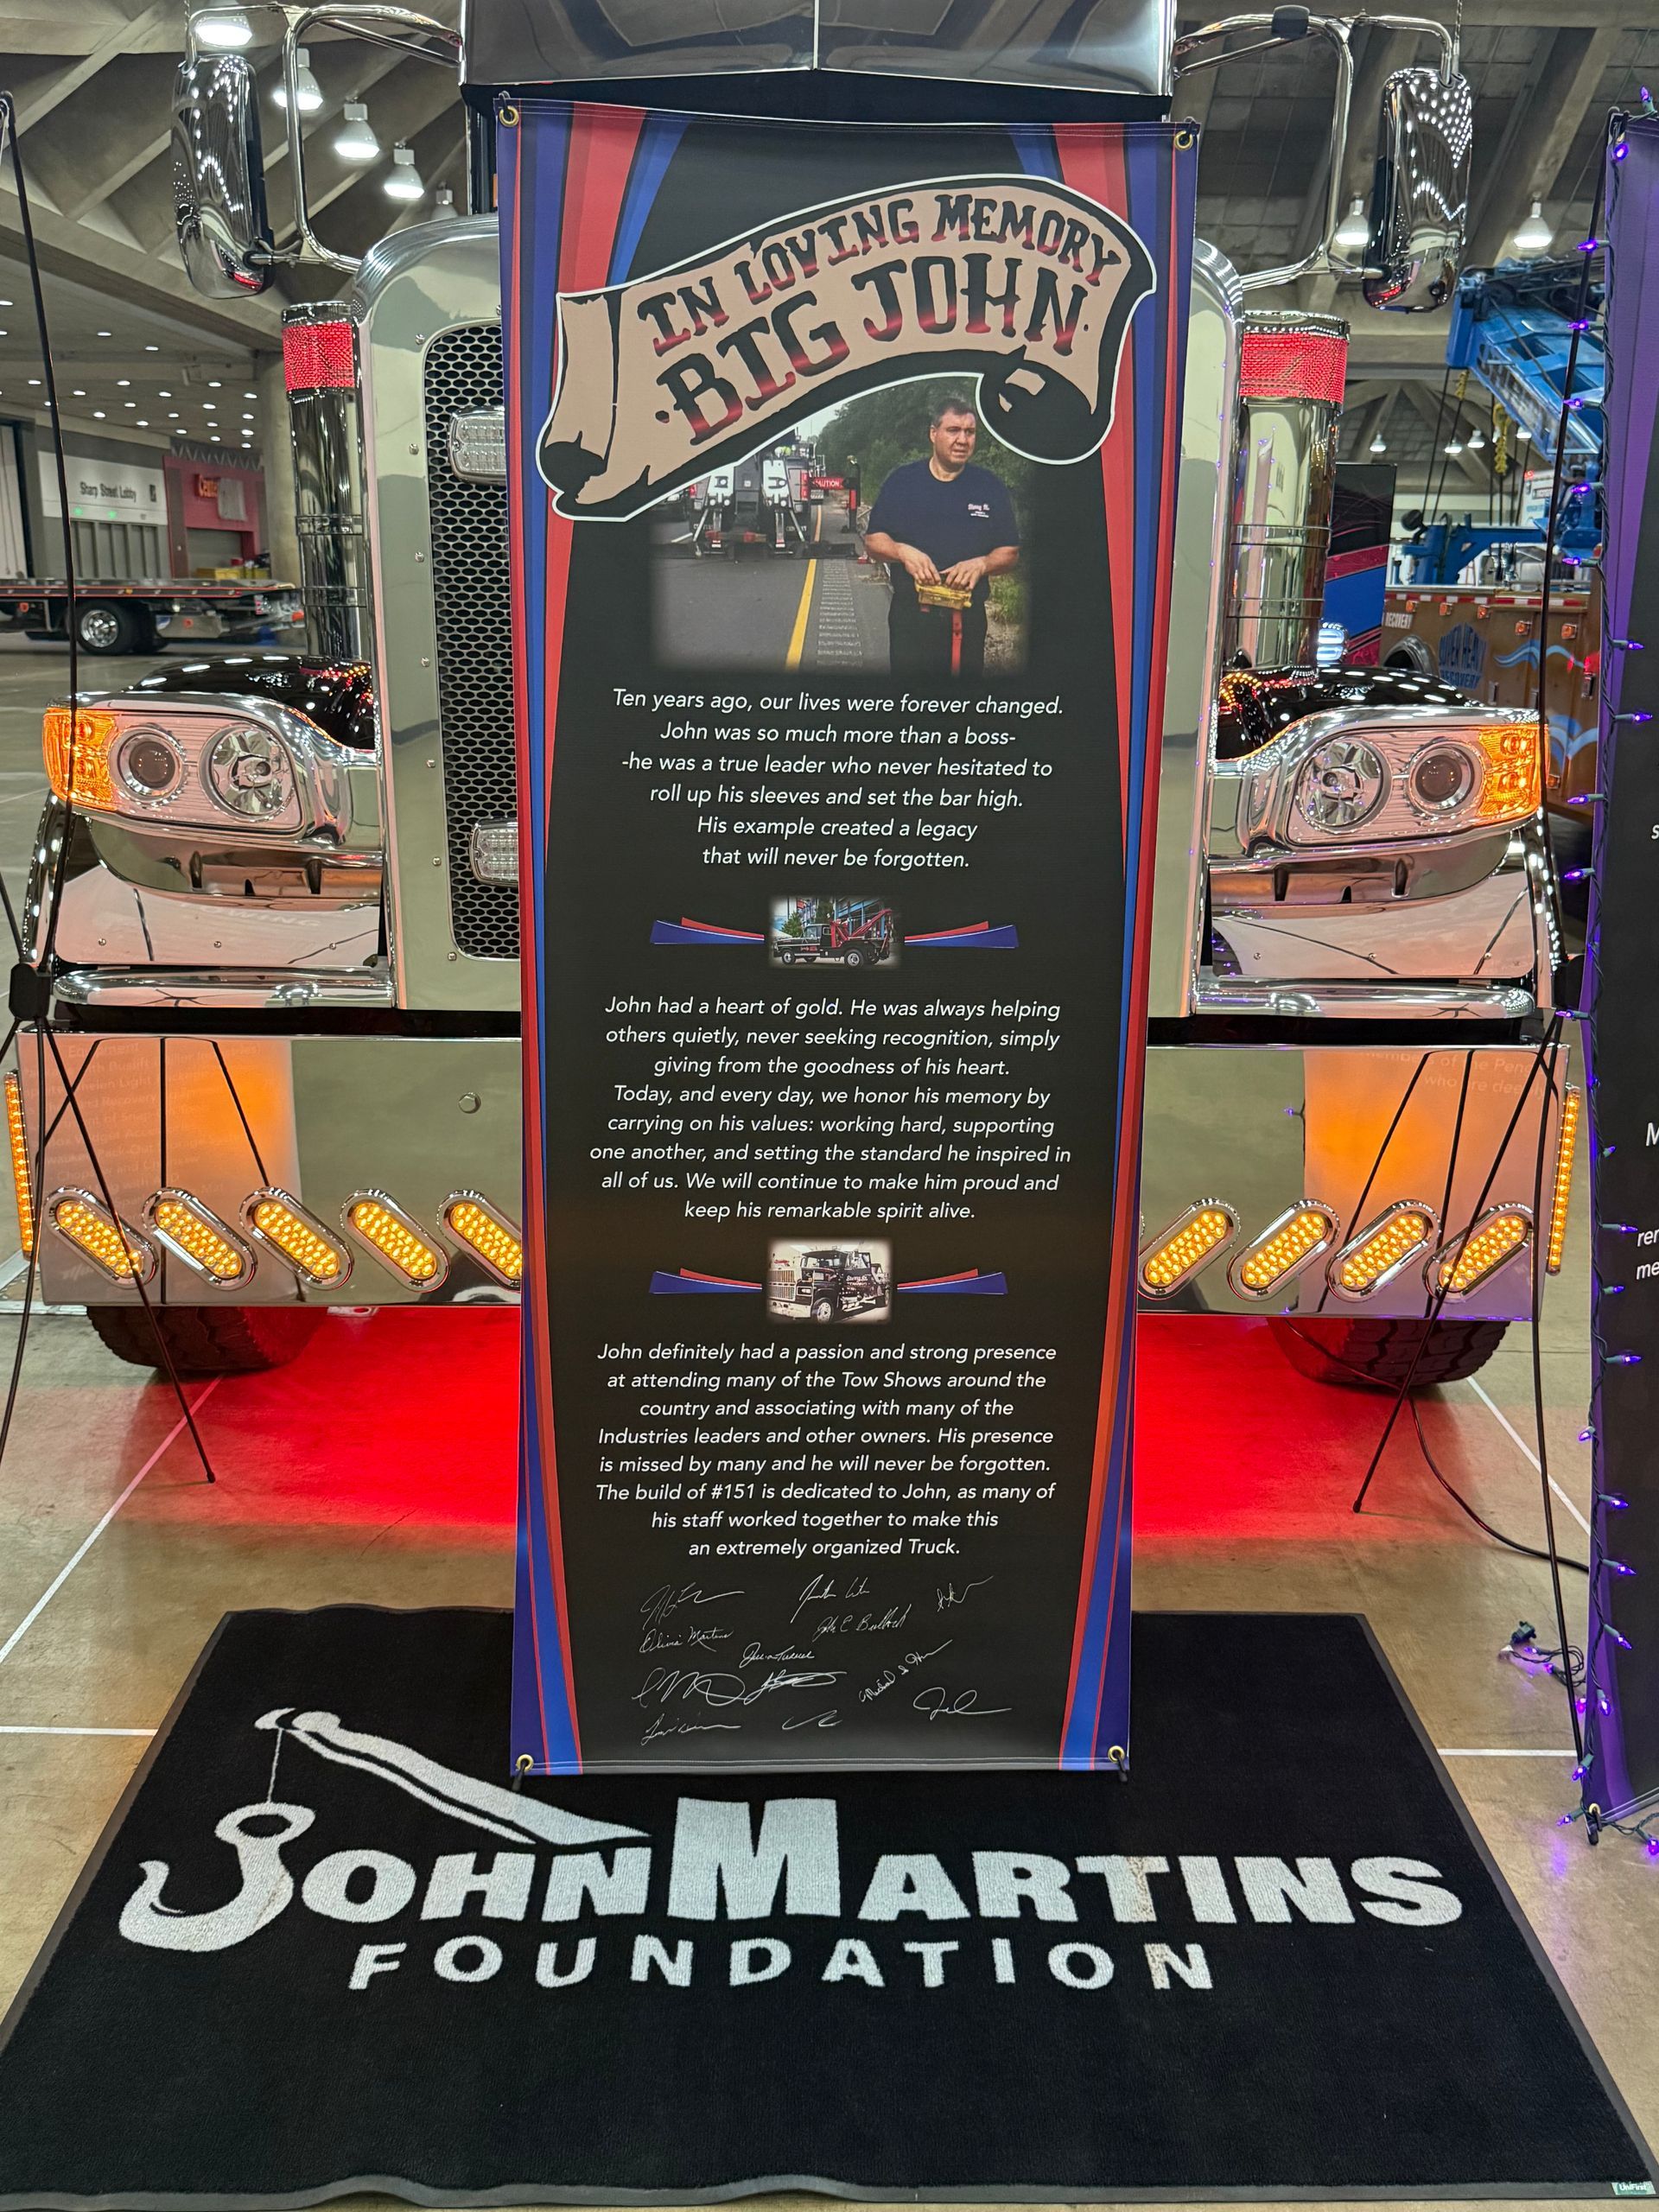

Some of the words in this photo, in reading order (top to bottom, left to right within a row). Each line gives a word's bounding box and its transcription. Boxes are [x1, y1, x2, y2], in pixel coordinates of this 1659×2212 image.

[637, 277, 728, 356] IN
[734, 199, 920, 305] LOVING
[931, 194, 1121, 287] MEMORY
[656, 290, 850, 446] BIG
[851, 254, 1089, 356] JOHN
[79, 481, 99, 499] Sharp
[99, 483, 118, 499] Street
[119, 485, 137, 503] Lobby
[613, 688, 646, 707] Ten
[651, 694, 705, 712] years
[710, 696, 753, 714] ago,
[760, 696, 793, 710] our
[798, 691, 841, 711] lives
[847, 698, 894, 712] were
[899, 693, 971, 713] forever
[976, 695, 1063, 719] changed.
[659, 720, 708, 740] John
[714, 728, 751, 741] was
[756, 728, 779, 741] so
[785, 723, 837, 742] much
[842, 729, 894, 743] more
[899, 725, 942, 744] than
[947, 731, 959, 745] a
[658, 758, 696, 771] was
[702, 759, 713, 772] a
[718, 756, 759, 772] true
[765, 753, 826, 773] leader
[831, 755, 872, 774] who
[877, 761, 932, 775] never
[937, 756, 1028, 777] hesitated
[1032, 760, 1053, 777] to
[697, 816, 728, 834] His
[733, 816, 815, 841] example
[820, 817, 894, 836] created
[899, 823, 911, 836] a
[916, 818, 978, 842] legacy
[605, 995, 652, 1014] John
[658, 995, 694, 1014] had
[698, 1001, 709, 1014] a
[715, 996, 766, 1014] heart
[771, 996, 792, 1014] of
[795, 997, 843, 1020] gold.
[850, 999, 877, 1016] He
[882, 1004, 918, 1016] was
[923, 998, 986, 1021] always
[990, 999, 1061, 1023] helping
[606, 1025, 666, 1043] others
[672, 1026, 740, 1048] quietly,
[746, 1032, 800, 1044] never
[804, 1027, 877, 1050] seeking
[882, 1029, 993, 1050] recognition,
[999, 1028, 1061, 1052] simply
[653, 1056, 712, 1077] giving
[717, 1055, 761, 1073] from
[767, 1055, 798, 1074] the
[803, 1057, 895, 1078] goodness
[900, 1057, 922, 1075] of
[925, 1057, 951, 1075] his
[956, 1057, 1009, 1075] heart.
[589, 1147, 626, 1160] one
[631, 1142, 707, 1162] another,
[713, 1142, 749, 1160] and
[753, 1144, 819, 1166] setting
[823, 1143, 855, 1161] the
[860, 1143, 943, 1161] standard
[947, 1144, 970, 1161] he
[976, 1145, 1051, 1167] inspired
[1055, 1146, 1071, 1162] in
[601, 1171, 623, 1188] all
[628, 1171, 650, 1188] of
[653, 1177, 678, 1189] us.
[686, 1172, 715, 1189] We
[721, 1172, 753, 1189] will
[757, 1173, 838, 1190] continue
[842, 1175, 863, 1190] to
[868, 1173, 918, 1190] make
[924, 1173, 957, 1190] him
[962, 1173, 1020, 1196] proud
[1024, 1173, 1060, 1191] and
[684, 1200, 731, 1224] keep
[736, 1200, 762, 1217] his
[767, 1200, 872, 1218] remarkable
[876, 1202, 924, 1224] spirit
[928, 1201, 975, 1218] alive.
[597, 1342, 643, 1359] John
[648, 1342, 735, 1364] definitely
[740, 1342, 775, 1359] had
[779, 1347, 790, 1359] a
[794, 1343, 864, 1364] passion
[869, 1343, 906, 1360] and
[909, 1345, 969, 1364] strong
[973, 1348, 1057, 1365] presence
[607, 1373, 626, 1388] at
[631, 1370, 721, 1392] attending
[726, 1376, 777, 1392] many
[781, 1370, 802, 1388] of
[805, 1370, 836, 1388] the
[842, 1371, 879, 1388] Tow
[883, 1370, 942, 1388] Shows
[946, 1370, 1012, 1388] around
[1016, 1370, 1046, 1388] the
[600, 1456, 613, 1472] is
[619, 1455, 684, 1472] missed
[689, 1454, 712, 1477] by
[716, 1459, 767, 1476] many
[771, 1454, 806, 1471] and
[810, 1454, 834, 1471] he
[839, 1454, 869, 1471] will
[874, 1459, 926, 1471] never
[931, 1454, 954, 1471] be
[959, 1453, 1050, 1476] forgotten.
[595, 1483, 630, 1500] The
[635, 1483, 682, 1500] build
[686, 1482, 708, 1500] of
[710, 1483, 754, 1499] #151
[761, 1483, 775, 1499] is
[780, 1482, 874, 1499] dedicated
[877, 1484, 898, 1499] to
[901, 1482, 951, 1502] John,
[957, 1487, 977, 1499] as
[982, 1487, 1032, 1503] many
[1036, 1482, 1057, 1499] of
[688, 1543, 710, 1556] an
[715, 1537, 808, 1560] extremely
[811, 1537, 903, 1559] organized
[908, 1537, 960, 1554] Truck.
[348, 1934, 1213, 1990] FOUNDATION
